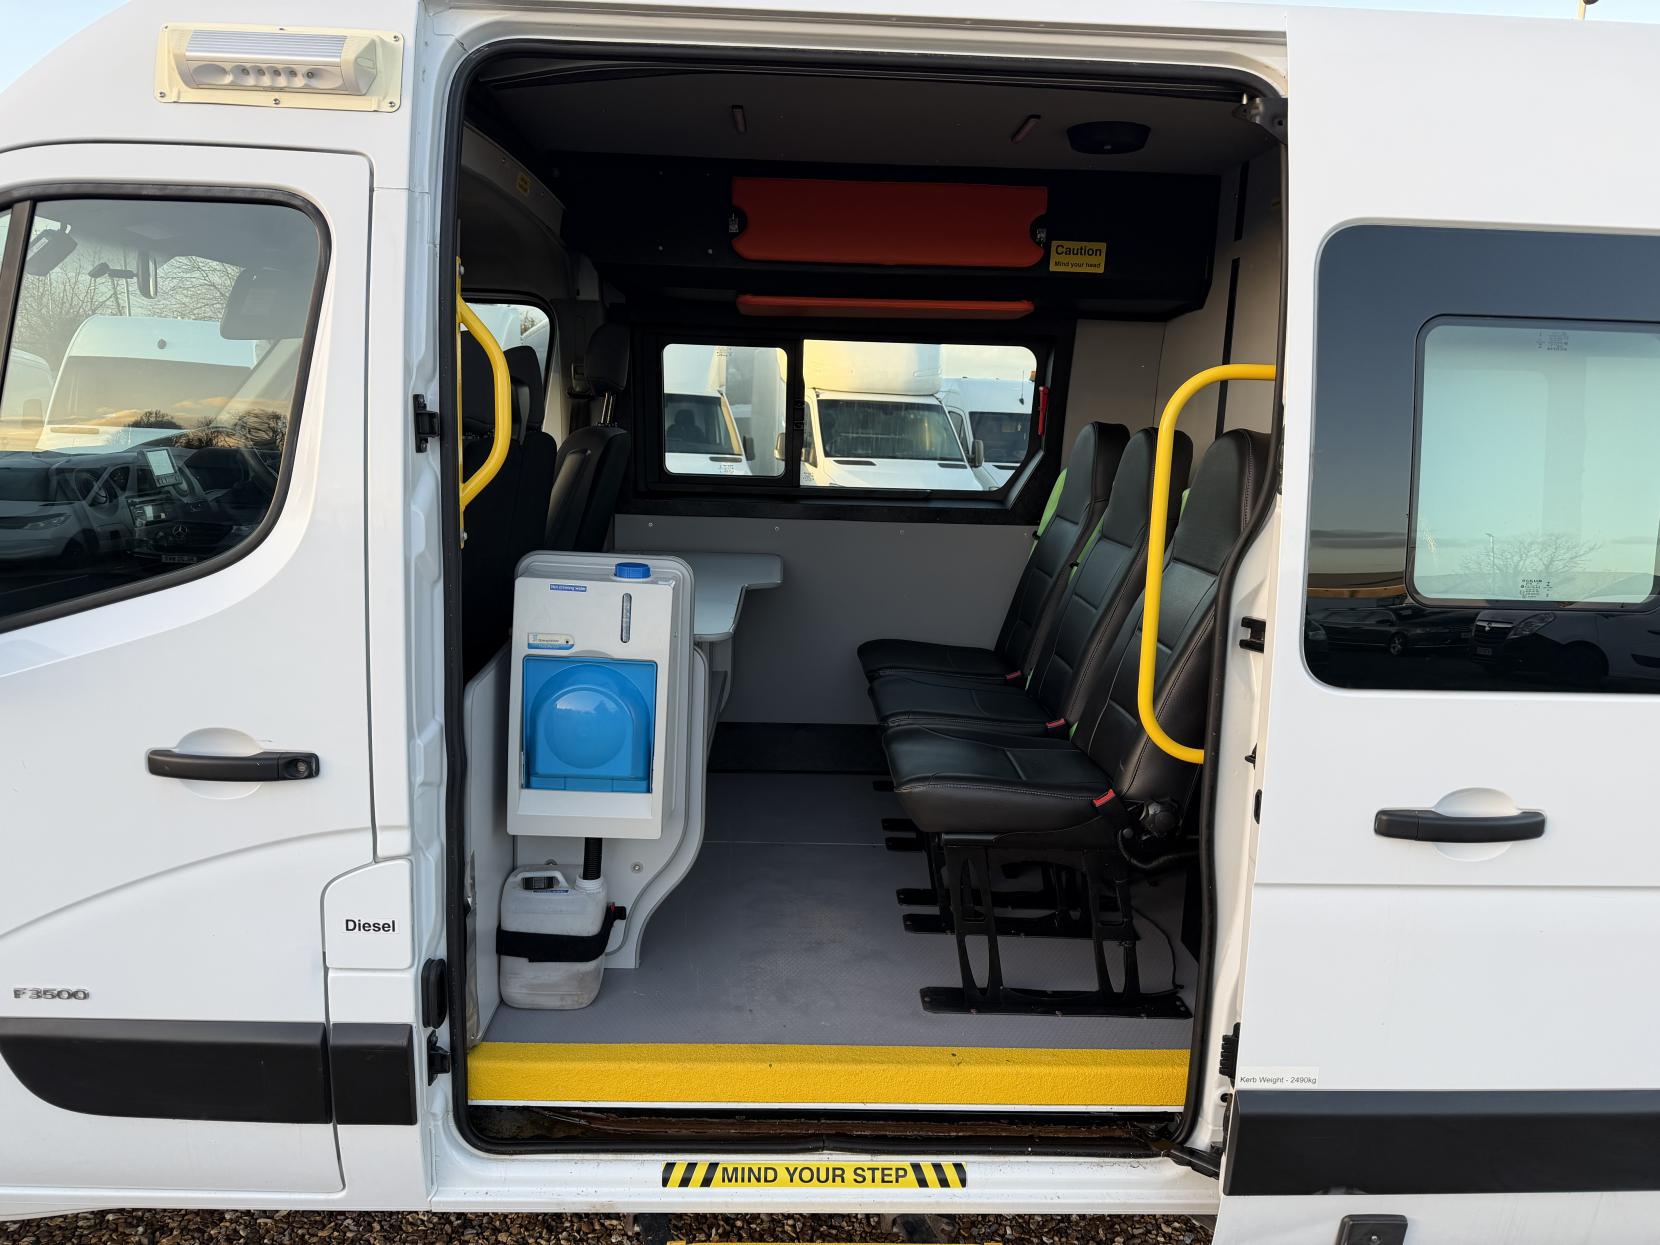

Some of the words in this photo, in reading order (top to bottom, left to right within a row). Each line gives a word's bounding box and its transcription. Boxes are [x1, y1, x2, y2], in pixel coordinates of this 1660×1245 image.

[1055, 244, 1102, 257] Caution
[345, 919, 396, 932] Diesel
[13, 987, 90, 1000] F3500
[1258, 1076, 1284, 1084] Weight
[1290, 1076, 1317, 1084] 2490kg
[721, 1166, 778, 1184] MIND
[784, 1166, 846, 1184] YOUR
[852, 1166, 908, 1184] STEP
